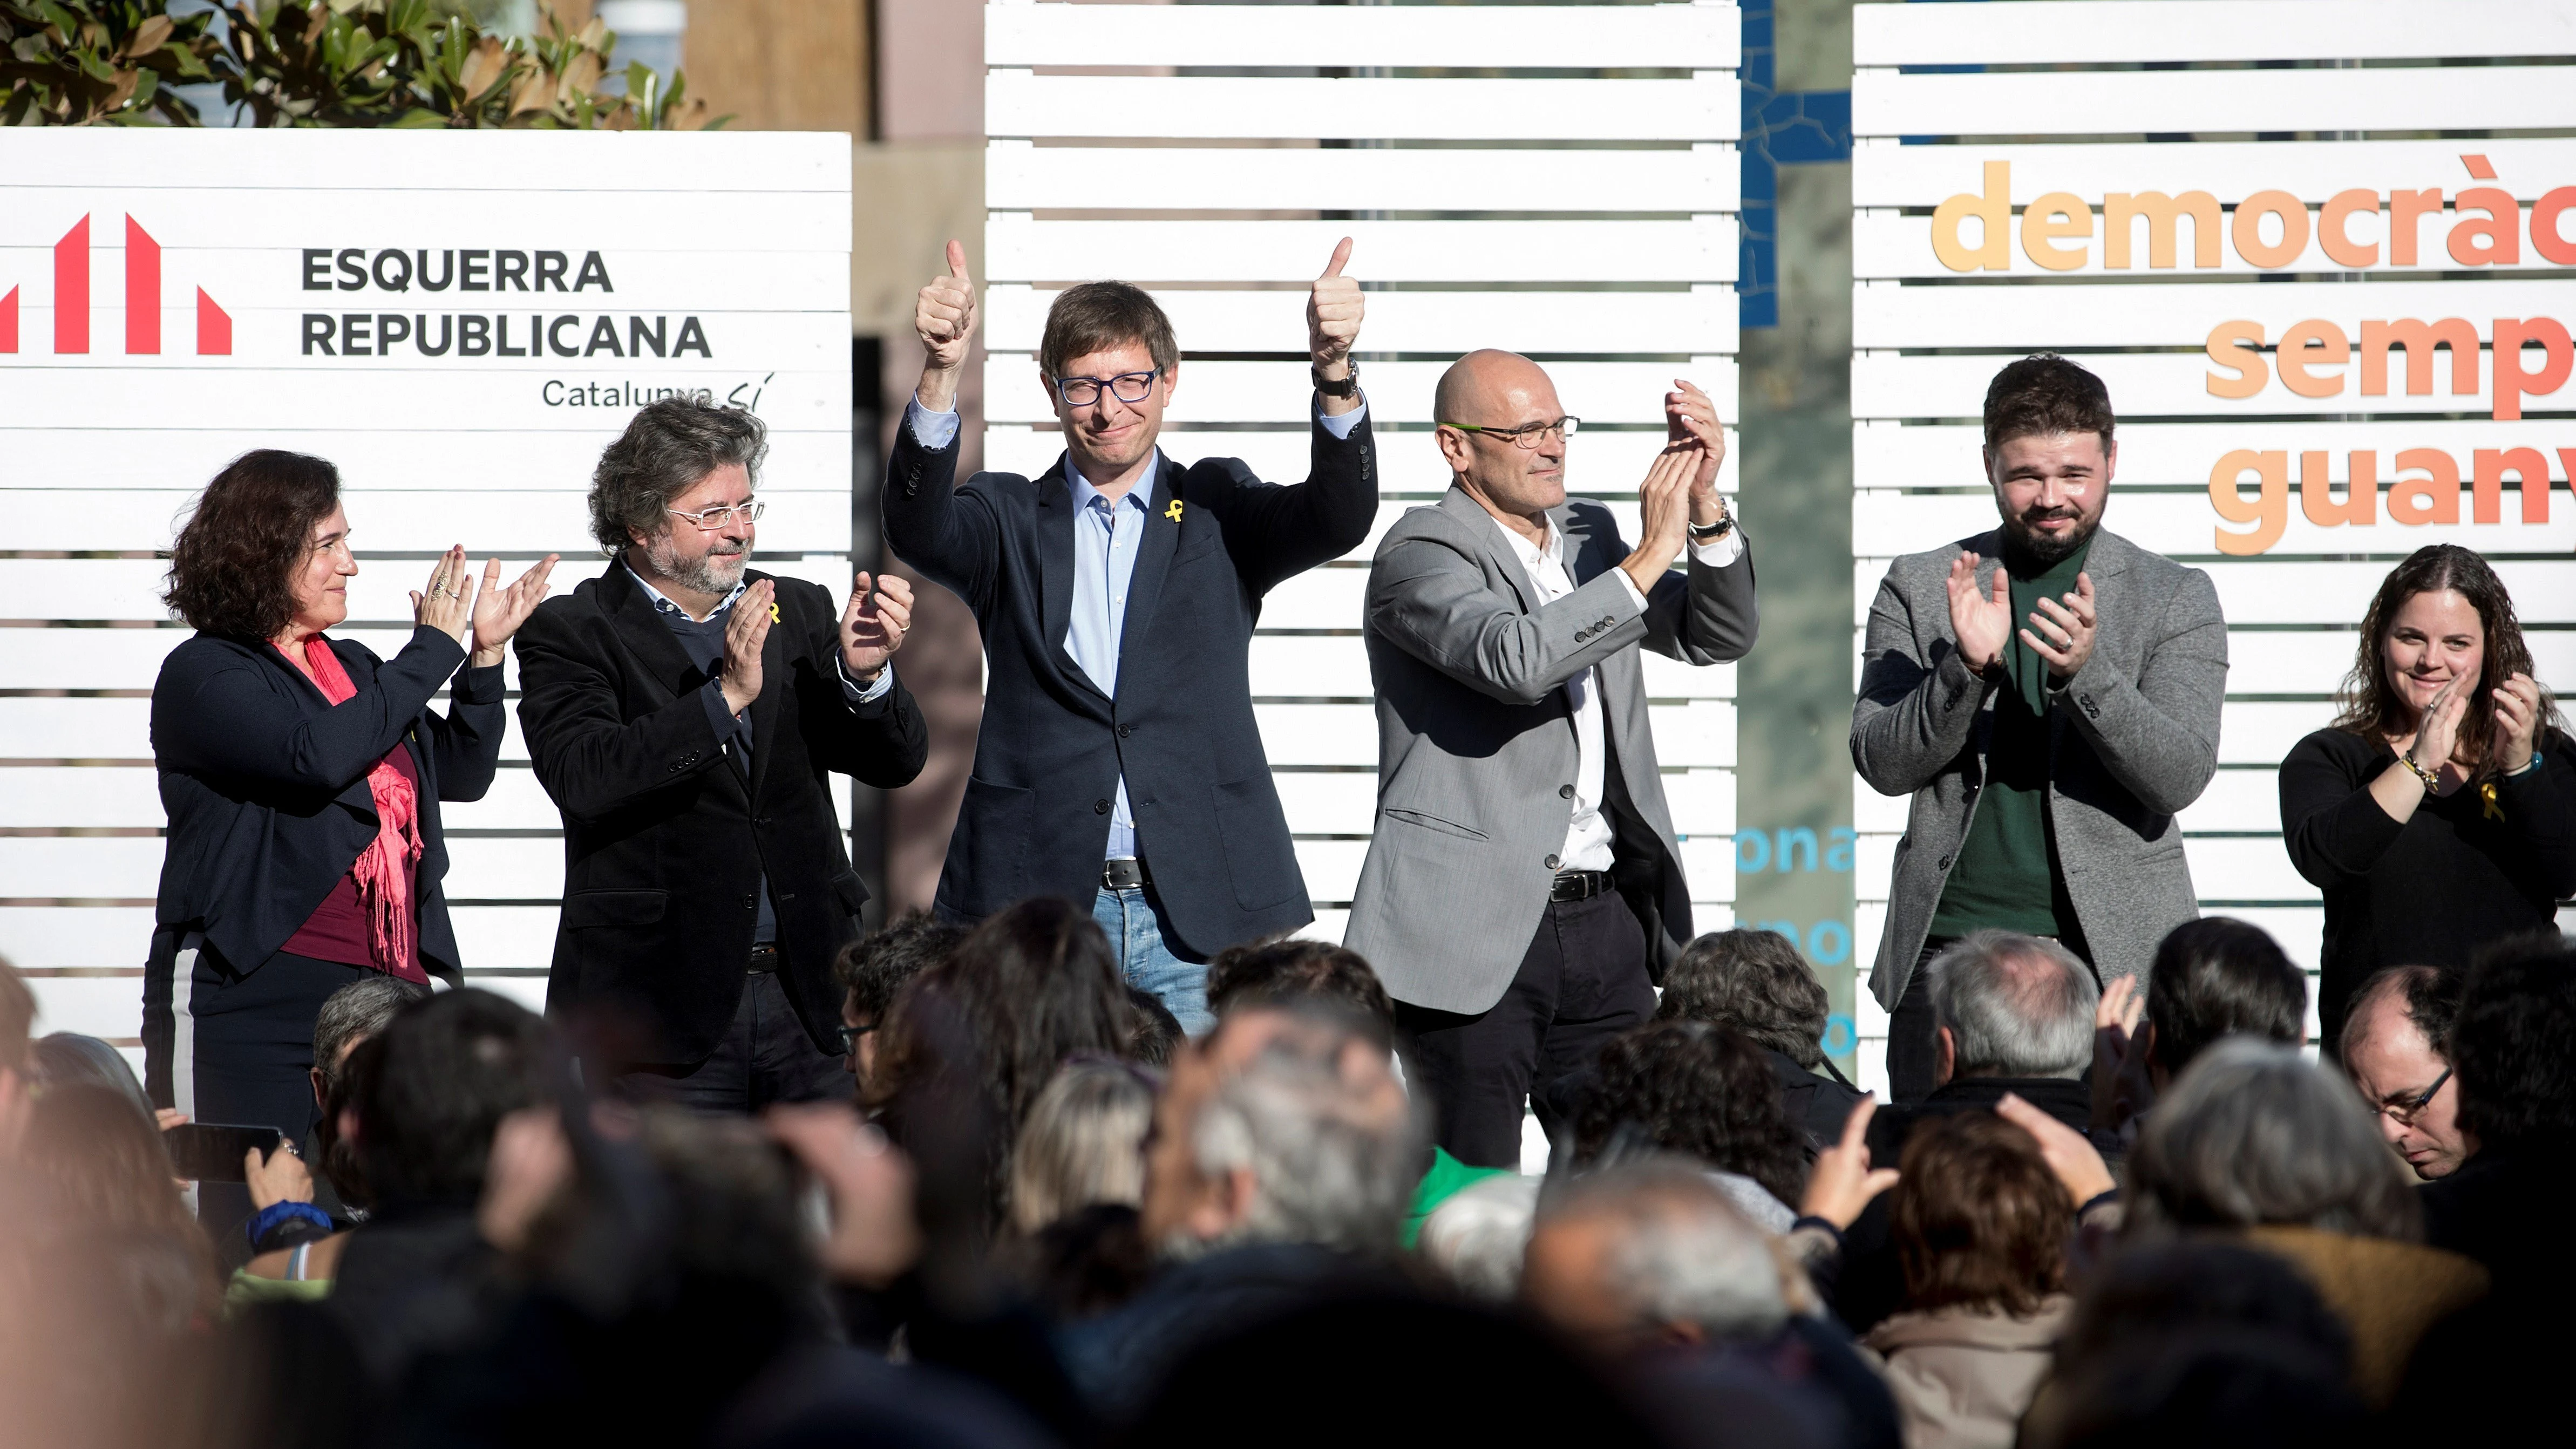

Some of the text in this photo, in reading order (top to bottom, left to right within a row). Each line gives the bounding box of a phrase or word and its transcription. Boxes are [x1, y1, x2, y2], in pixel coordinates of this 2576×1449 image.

[302, 248, 614, 293] ESQUERRA
[302, 314, 712, 358] REPUBLICANA
[2206, 317, 2574, 421] semp
[543, 380, 711, 406] Cataluna
[2209, 446, 2576, 555] guan
